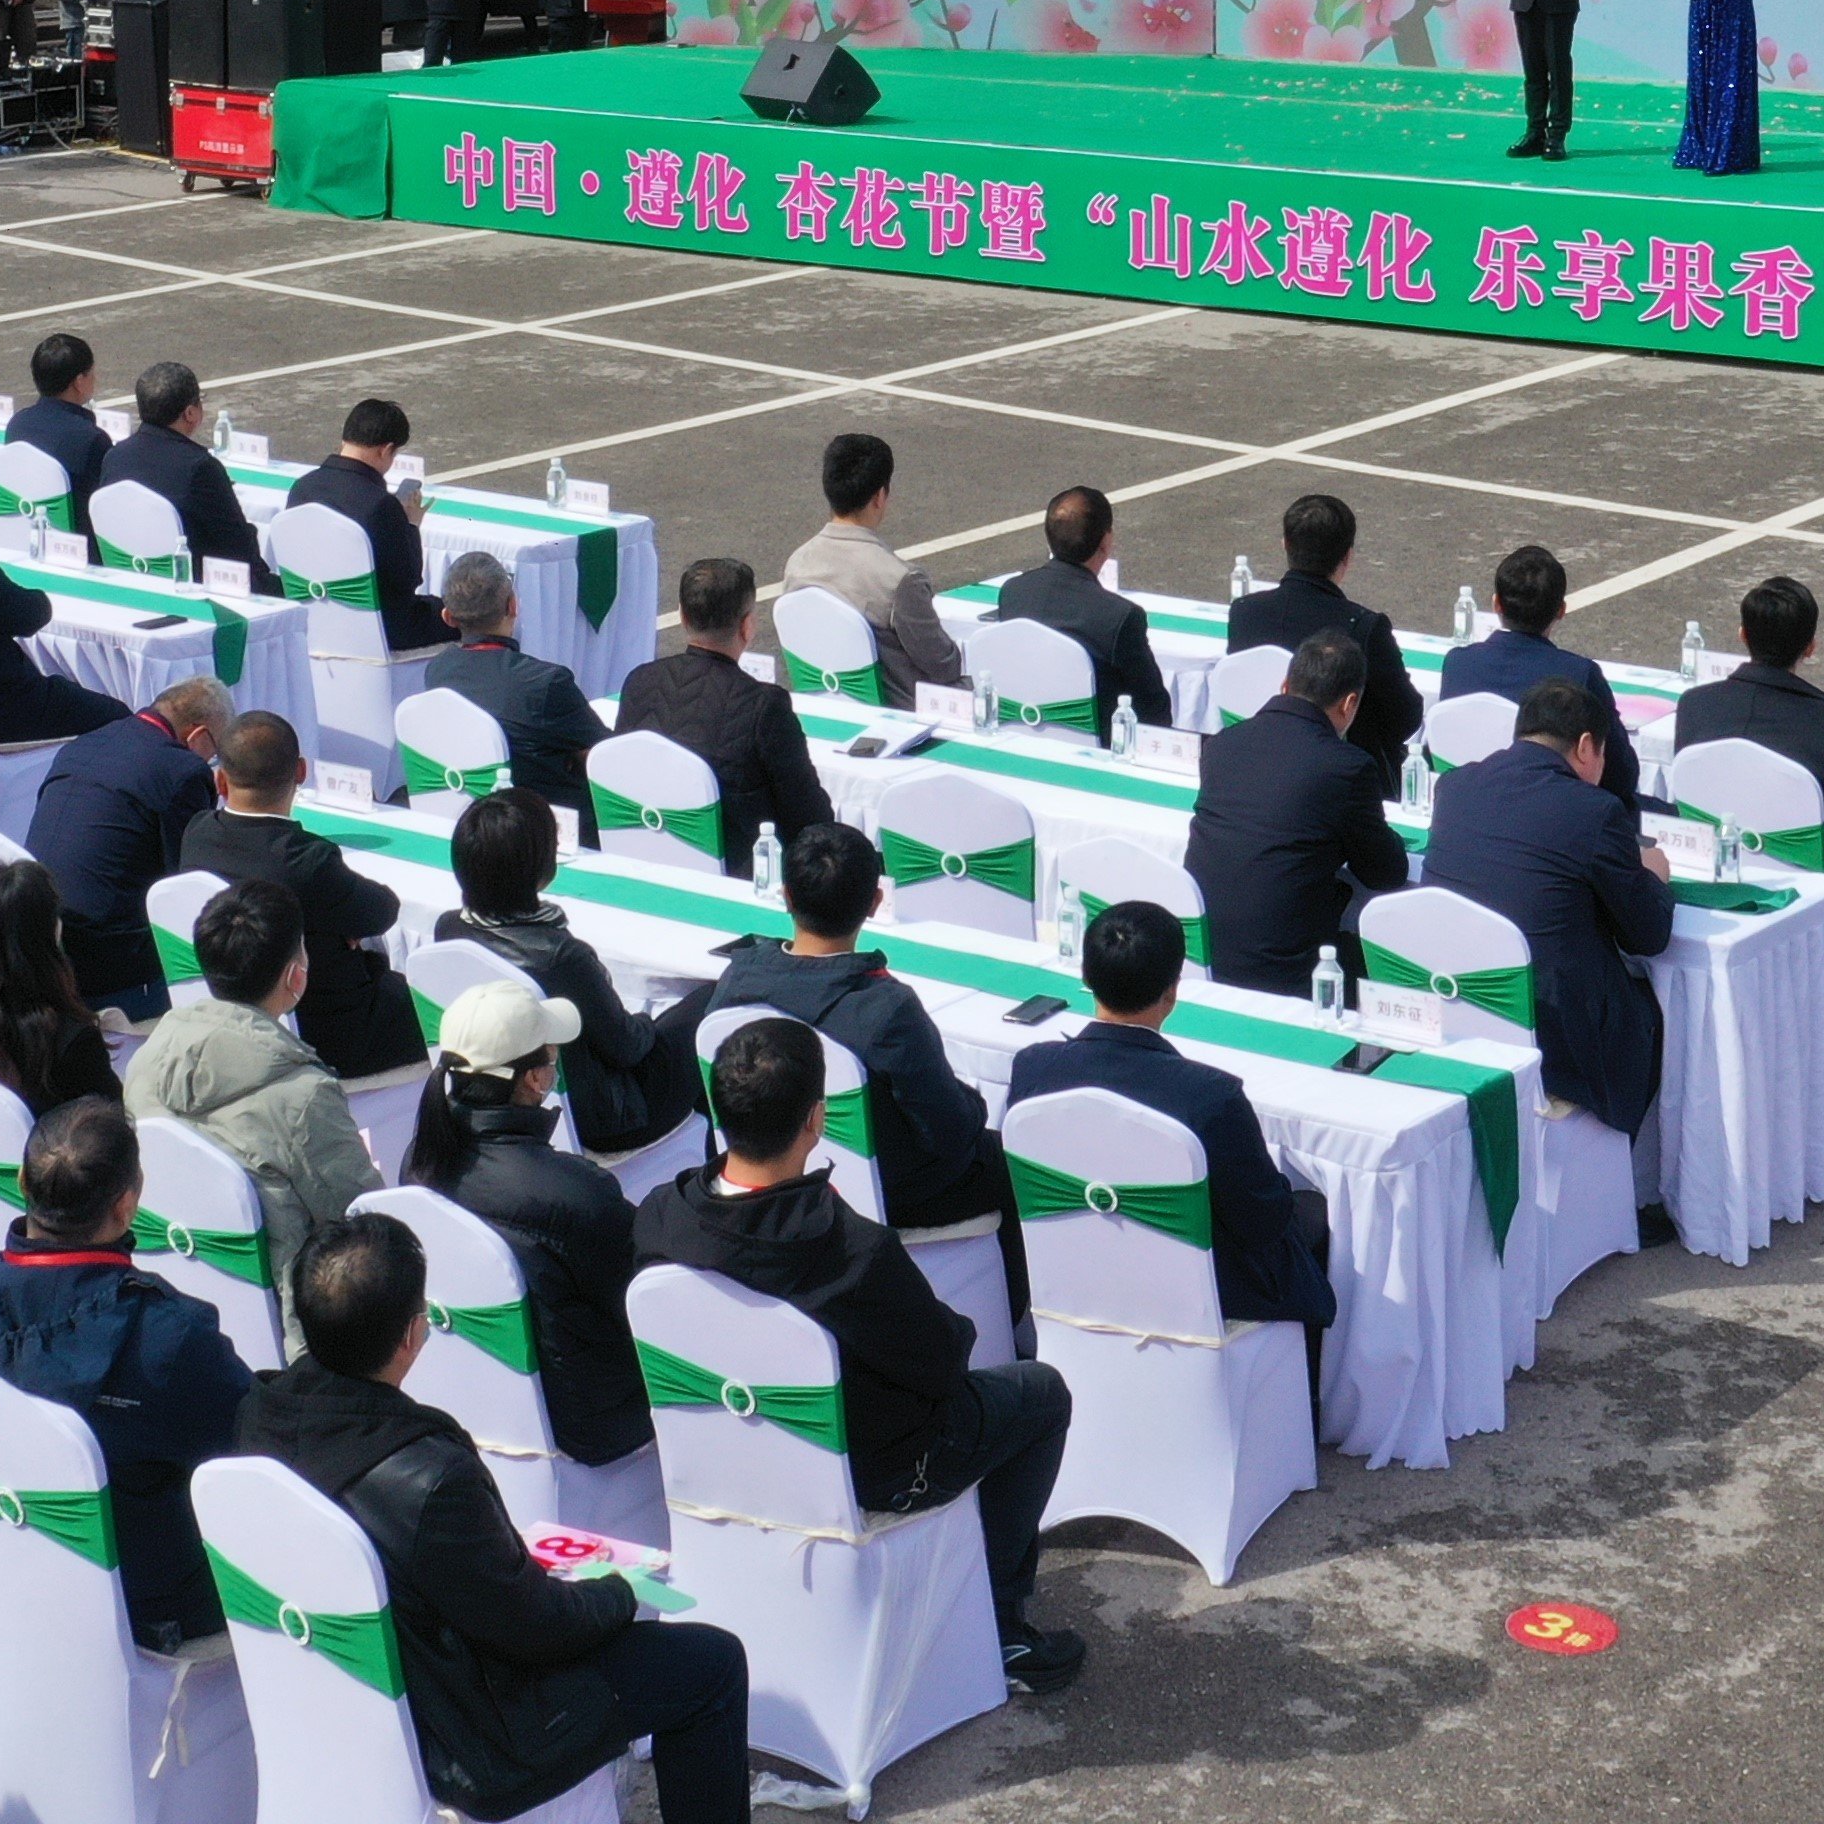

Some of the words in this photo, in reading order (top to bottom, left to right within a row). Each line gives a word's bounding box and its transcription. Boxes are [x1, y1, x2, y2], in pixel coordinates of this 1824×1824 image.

[443, 130, 750, 234] 中国·遵化
[775, 159, 1047, 263] 杏花节暨
